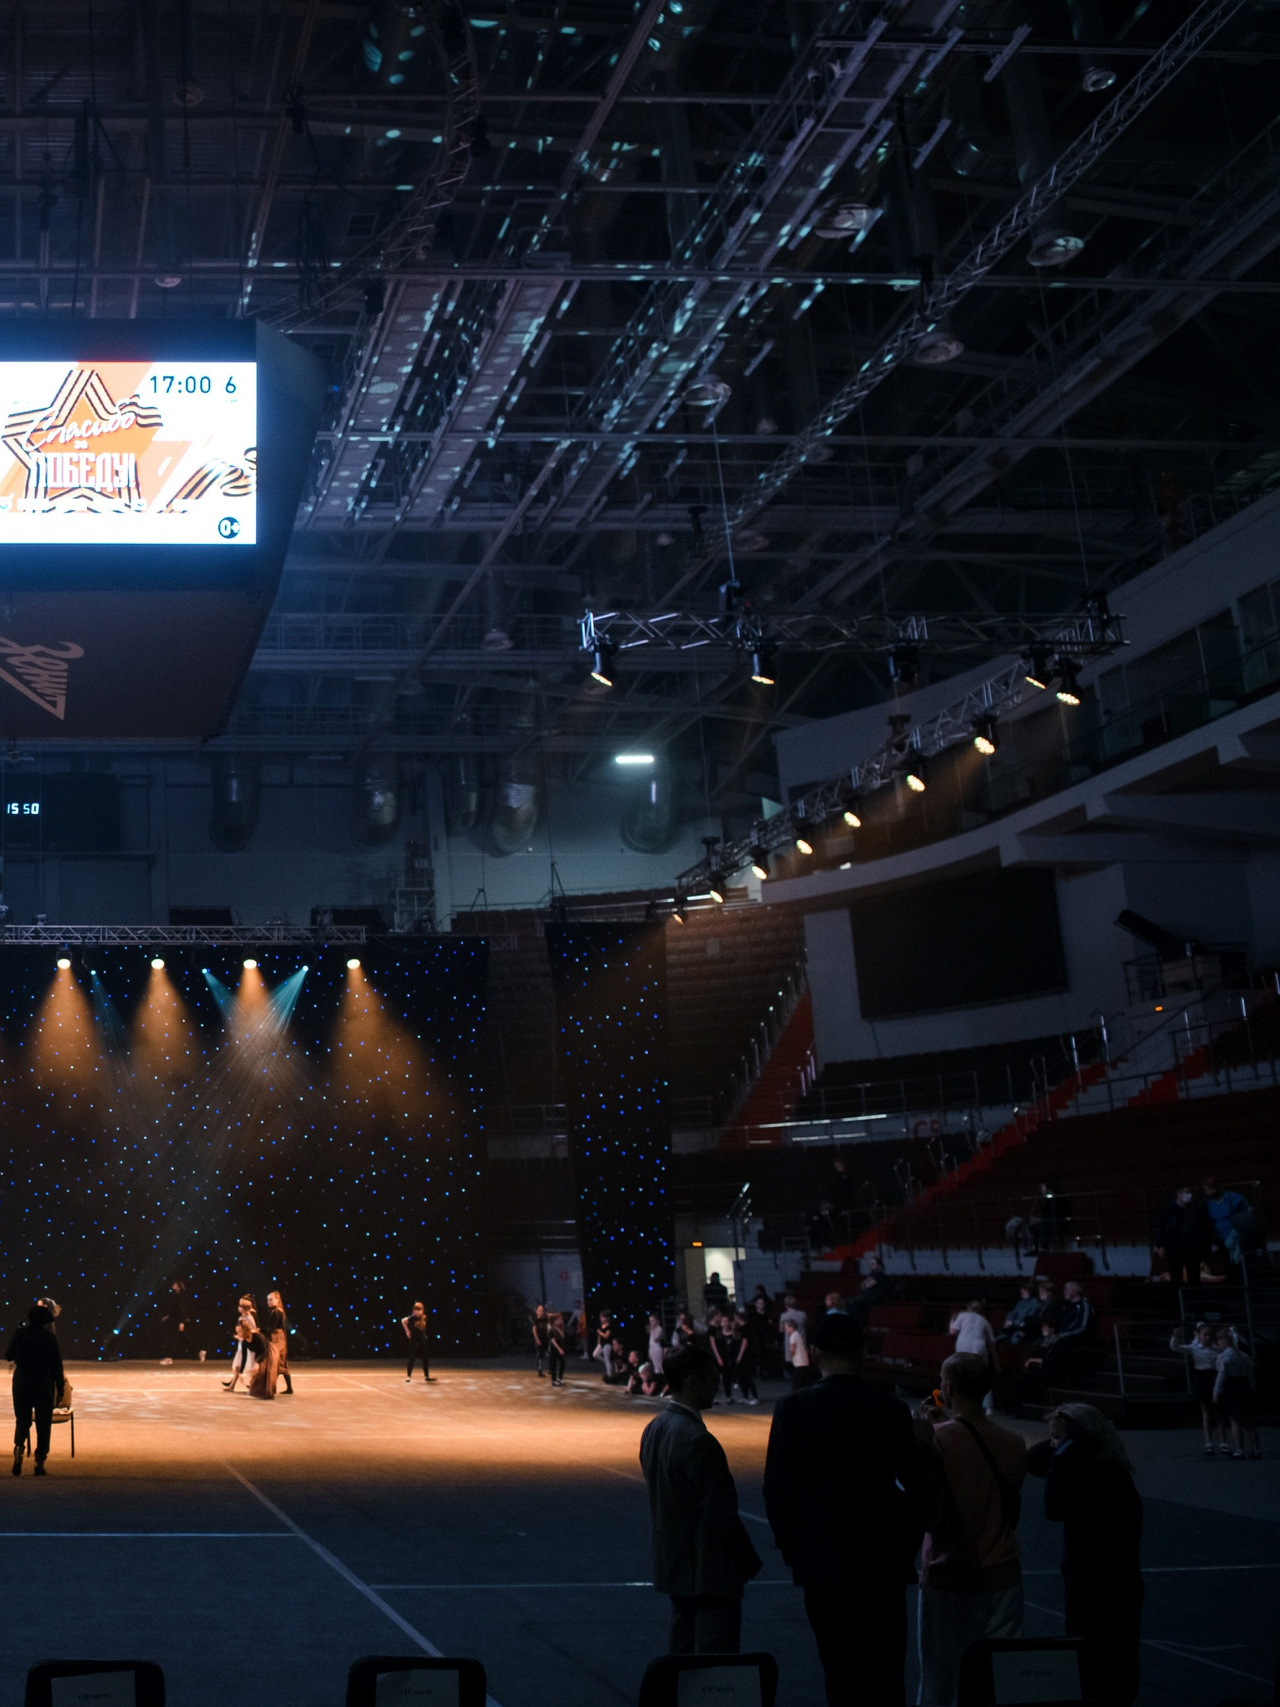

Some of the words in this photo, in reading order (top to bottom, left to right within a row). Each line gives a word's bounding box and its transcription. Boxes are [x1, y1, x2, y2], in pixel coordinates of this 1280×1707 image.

[150, 376, 211, 394] 17:00
[225, 376, 236, 394] 6
[23, 398, 136, 452] Спасибо
[30, 452, 137, 492] ПОБЕДУ!
